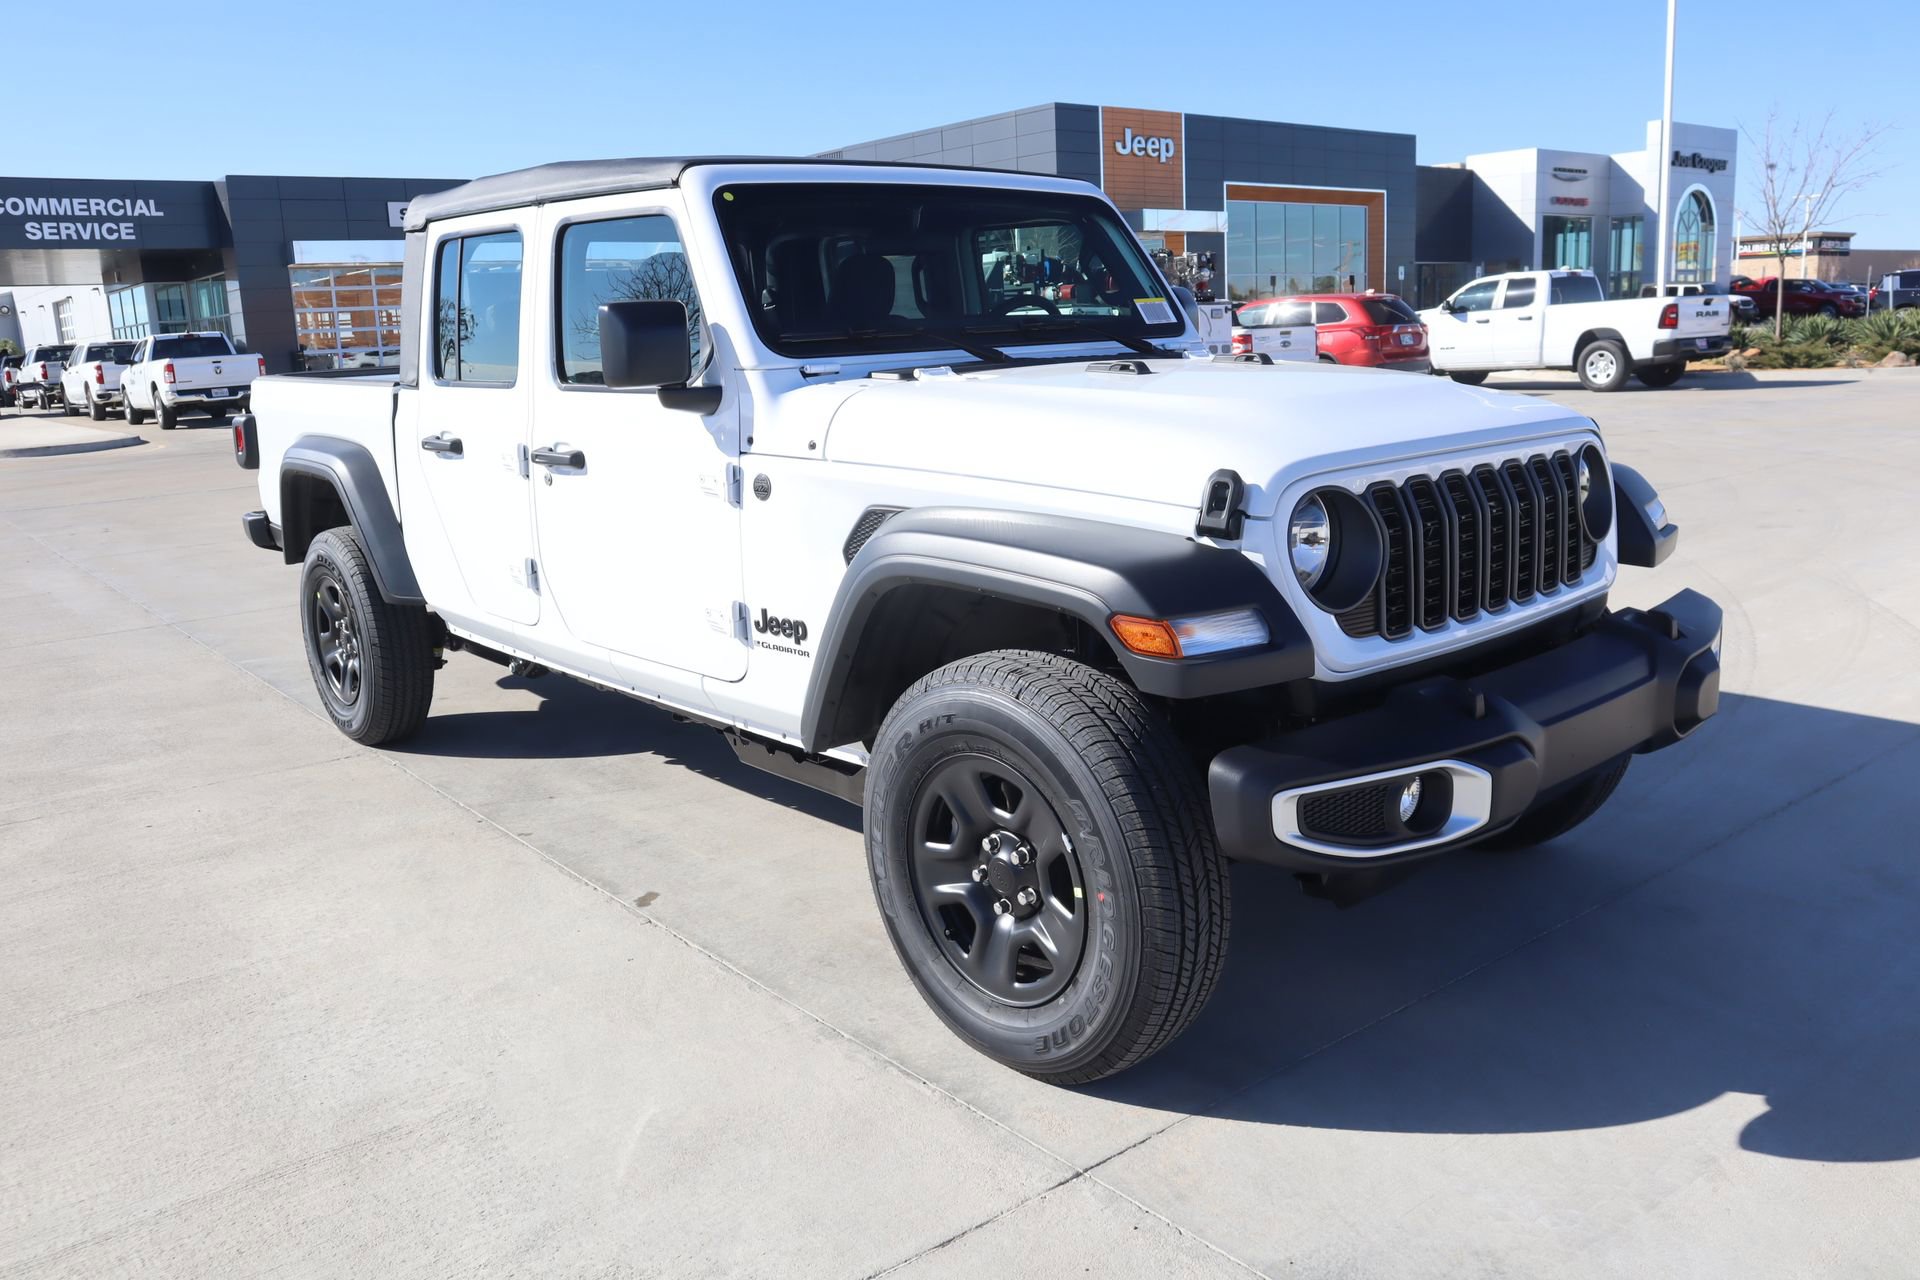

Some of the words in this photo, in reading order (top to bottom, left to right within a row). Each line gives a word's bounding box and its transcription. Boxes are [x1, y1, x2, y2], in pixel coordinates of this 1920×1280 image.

[1114, 127, 1175, 164] Jeep
[0, 197, 164, 216] OMMERCIAL
[24, 222, 136, 240] SERVICE
[754, 607, 808, 646] Jeep
[761, 641, 810, 658] GLADIATOR
[919, 712, 957, 734] H/T
